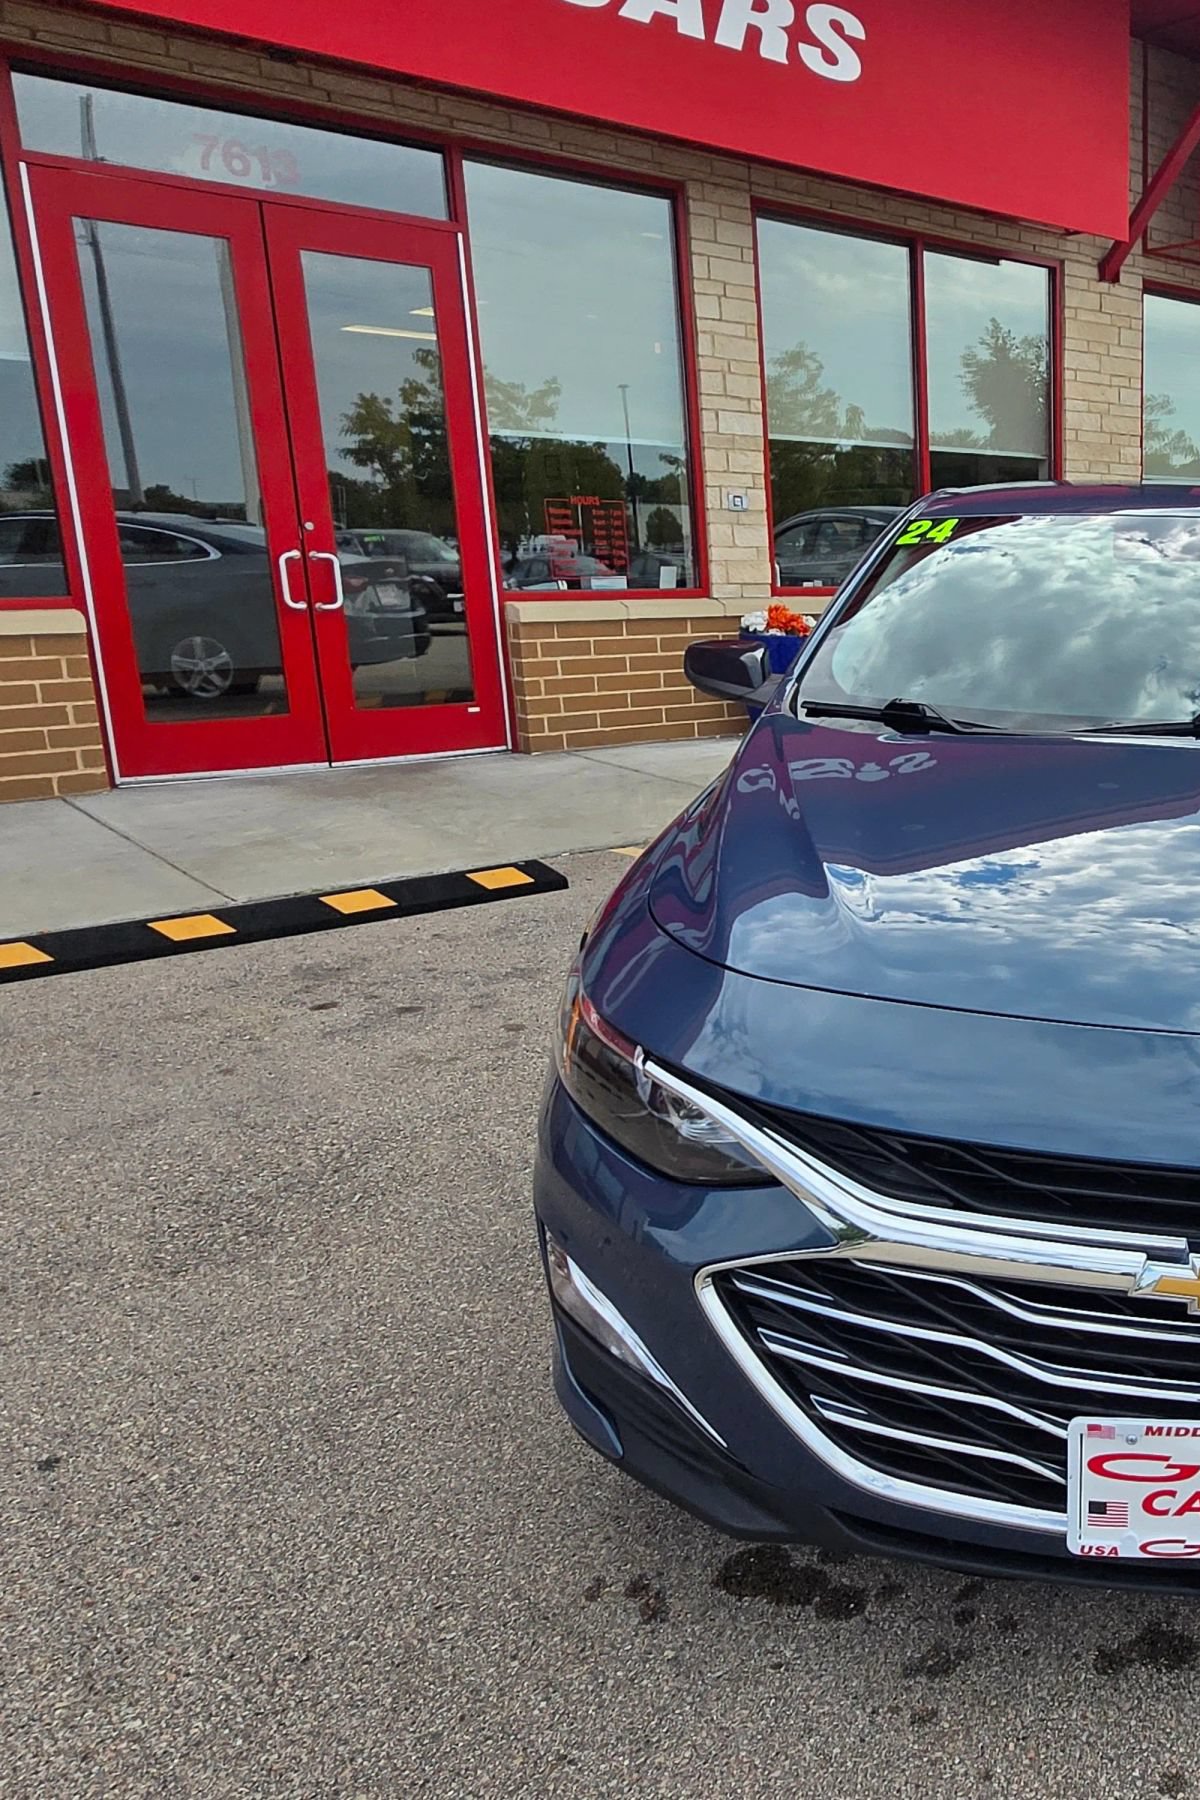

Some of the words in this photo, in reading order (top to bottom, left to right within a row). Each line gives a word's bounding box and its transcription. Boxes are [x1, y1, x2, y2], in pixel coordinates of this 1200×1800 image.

[563, 0, 867, 82] ARS
[569, 495, 600, 505] HOURS
[895, 518, 960, 546] 24
[1079, 1544, 1120, 1557] USA
